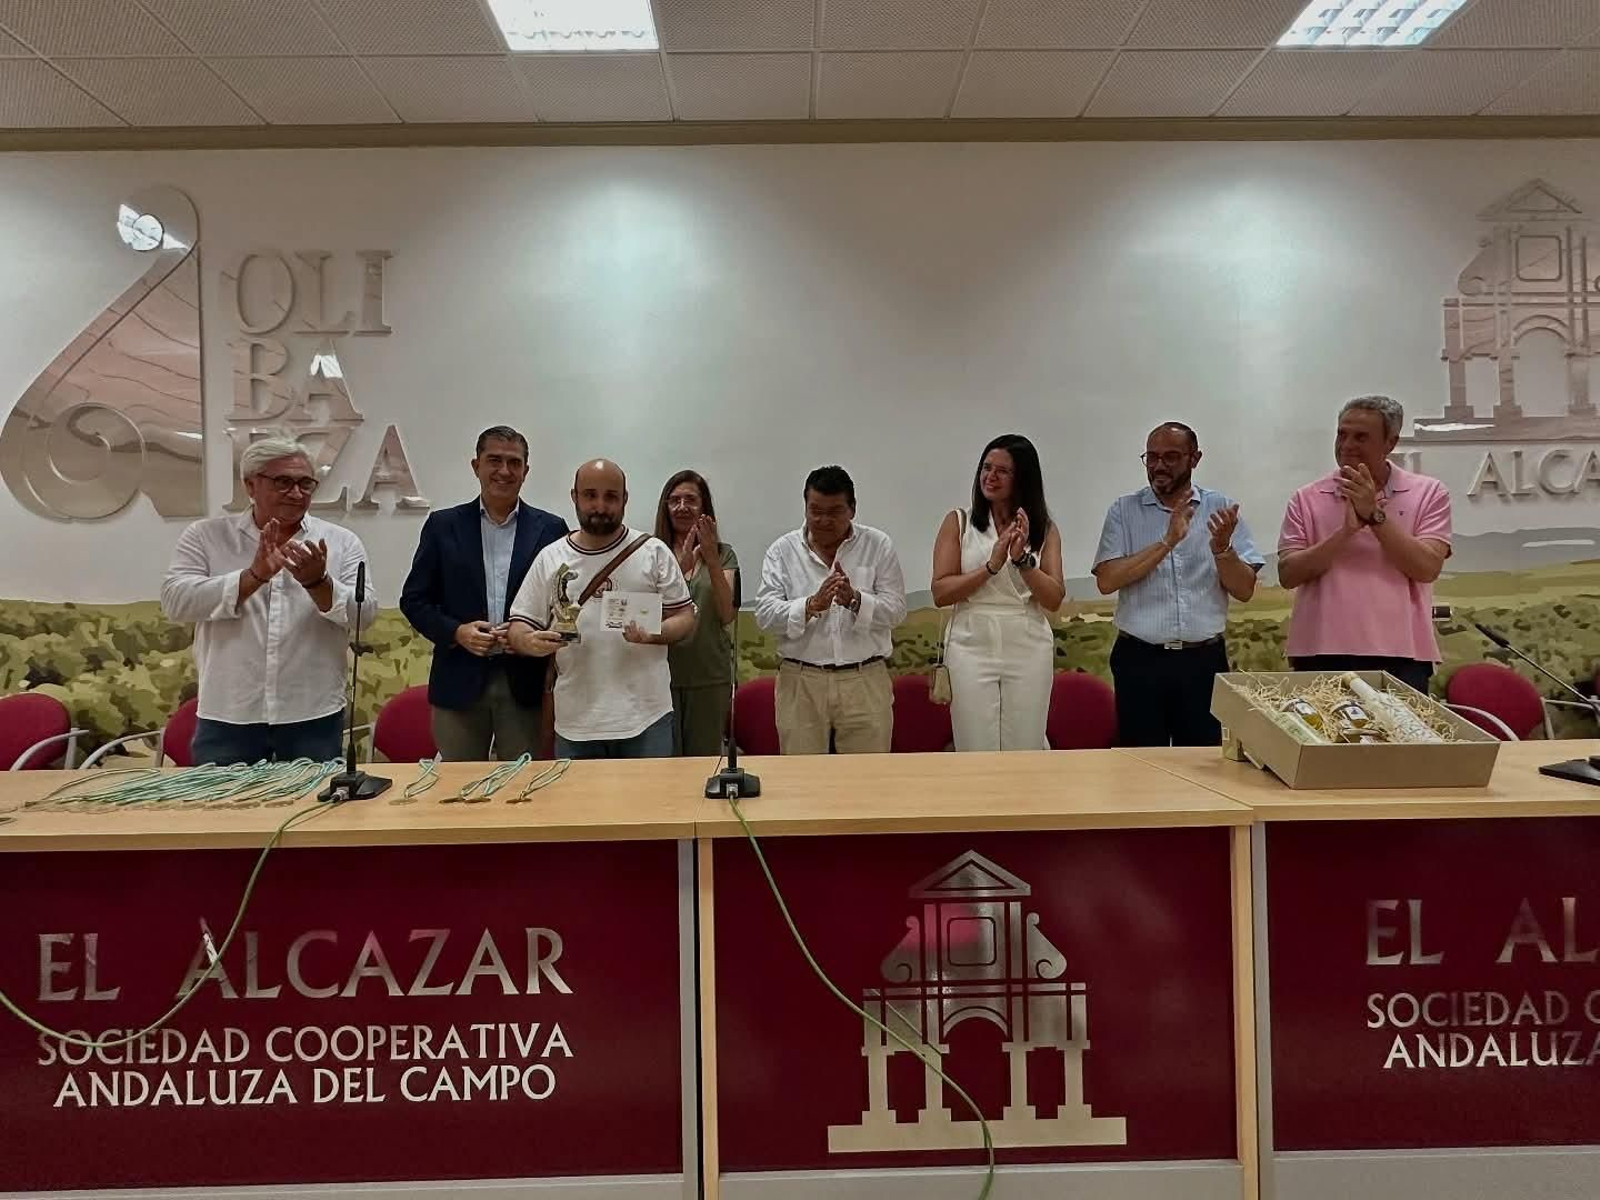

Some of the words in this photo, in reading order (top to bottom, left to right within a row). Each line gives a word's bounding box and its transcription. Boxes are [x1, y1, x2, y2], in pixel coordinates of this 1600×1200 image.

[223, 248, 394, 336] OLI
[225, 339, 365, 421] BA
[38, 933, 121, 1001] EL
[176, 917, 574, 999] ALCAZAR
[1366, 899, 1445, 965] EL
[1495, 897, 1600, 963] AL
[1367, 990, 1570, 1028] SOCIEDAD
[37, 1027, 250, 1066] SOCIEDAD
[266, 1023, 574, 1063] COOPERATIVA
[53, 1069, 299, 1107] ANDALUZA
[313, 1067, 386, 1103] DEL
[400, 1063, 556, 1101] CAMPO
